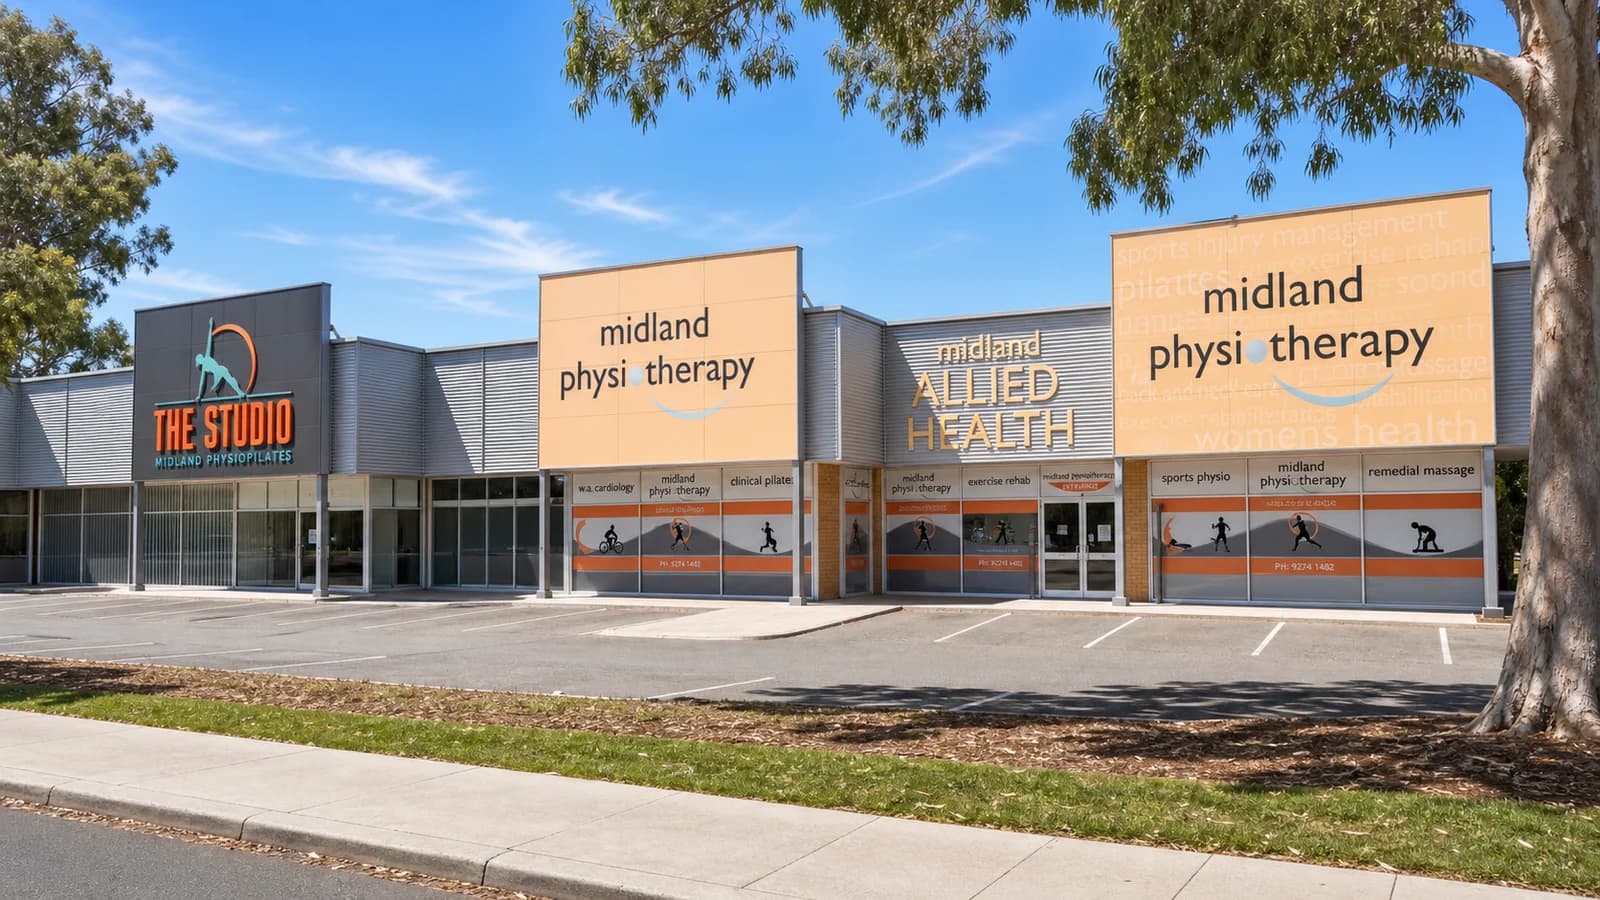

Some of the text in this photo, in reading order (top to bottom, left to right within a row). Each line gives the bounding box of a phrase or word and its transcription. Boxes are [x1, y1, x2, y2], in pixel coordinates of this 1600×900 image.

[1204, 264, 1363, 314] midland
[601, 306, 710, 347] midland
[937, 329, 1042, 363] midland
[911, 364, 1060, 408] ALLIED
[153, 398, 294, 452] THE STUDIO
[907, 407, 1075, 453] HEALTH
[1193, 423, 1339, 450] womens
[1355, 410, 1477, 446] health
[154, 449, 293, 469] MIDLAND PHYSIOPILATES
[1278, 460, 1325, 473] midland
[1368, 465, 1475, 478] remedial massage
[661, 473, 695, 484] midland
[730, 475, 762, 486] clinical
[902, 472, 935, 483] midland
[967, 475, 1031, 487] exercise rehab
[1161, 471, 1231, 485] sports physio
[594, 482, 635, 494] cardiology
[649, 485, 711, 499] physitherapy
[891, 483, 952, 496] physitherapy
[1291, 562, 1312, 571] 9274
[1315, 563, 1335, 572] 1482
